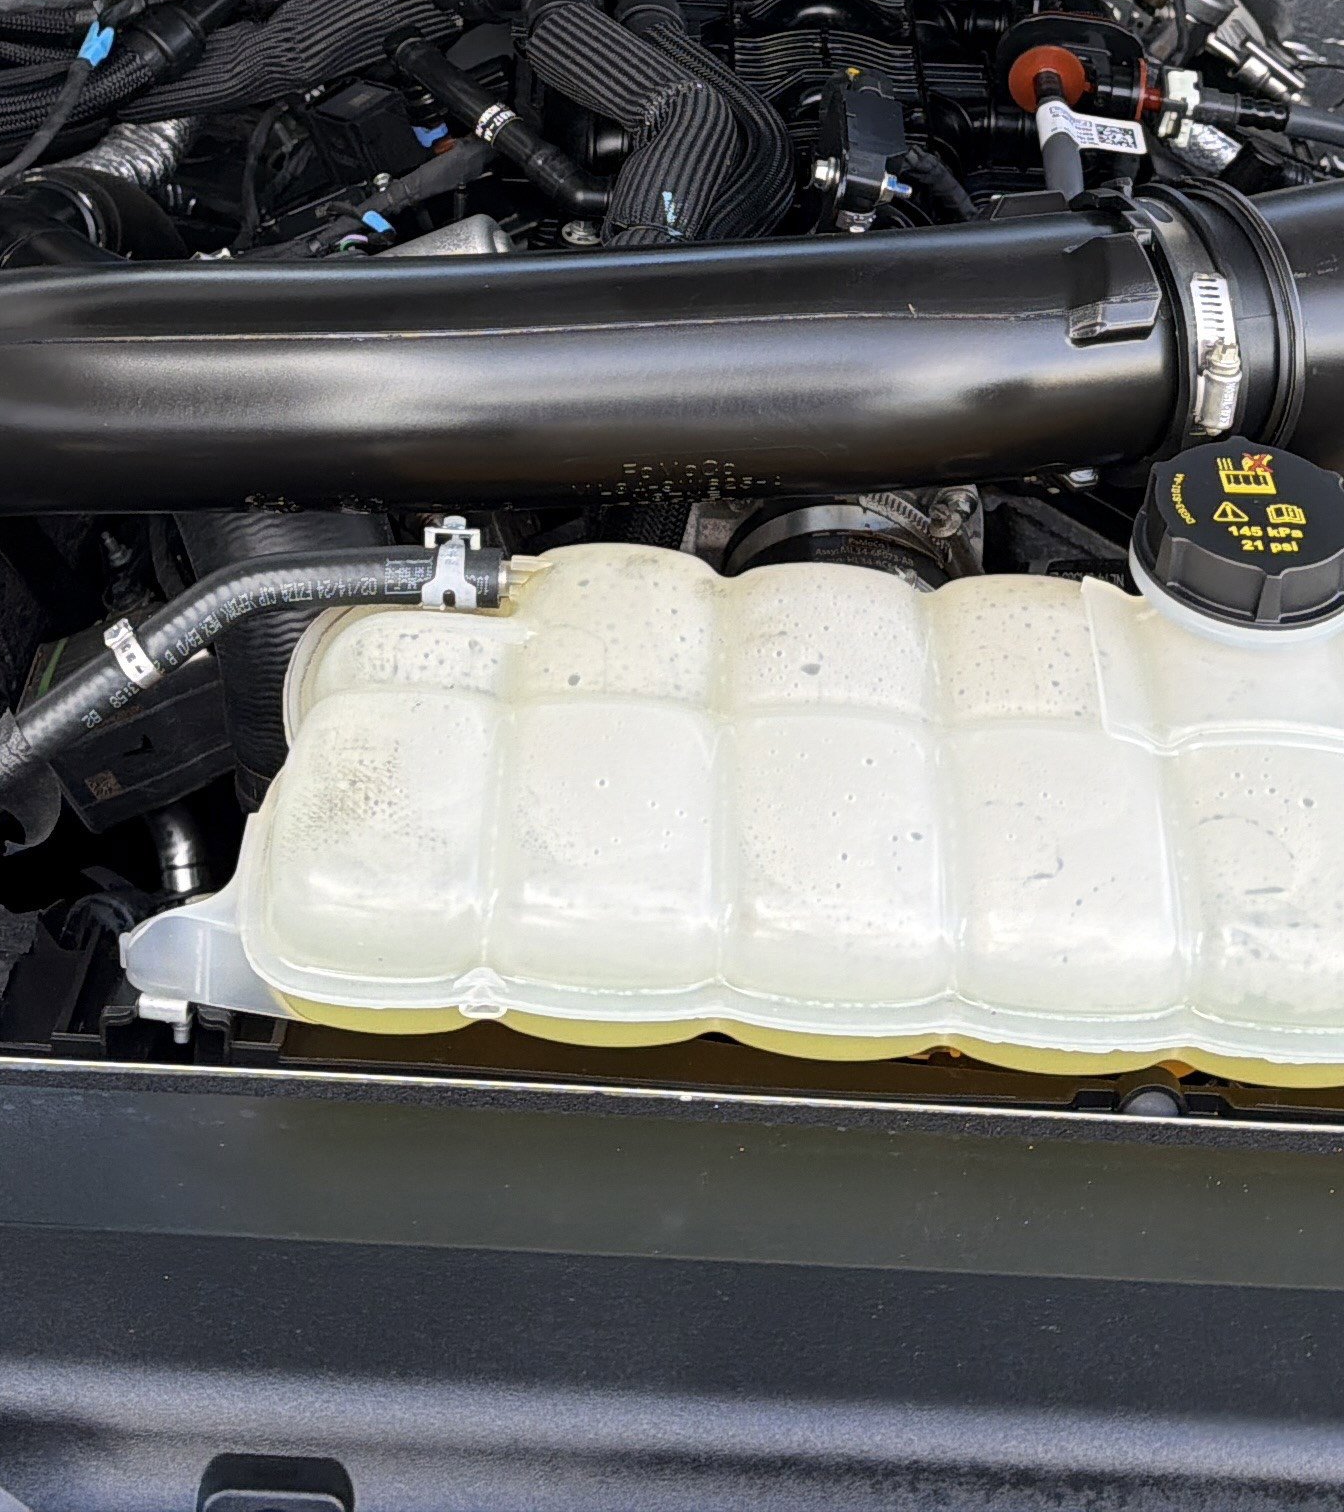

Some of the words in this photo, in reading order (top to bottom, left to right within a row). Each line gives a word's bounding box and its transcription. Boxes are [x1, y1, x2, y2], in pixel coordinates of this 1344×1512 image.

[1228, 526, 1263, 537] 145
[1267, 526, 1304, 538] kPa
[1242, 541, 1263, 551] 21
[1270, 541, 1299, 553] psi
